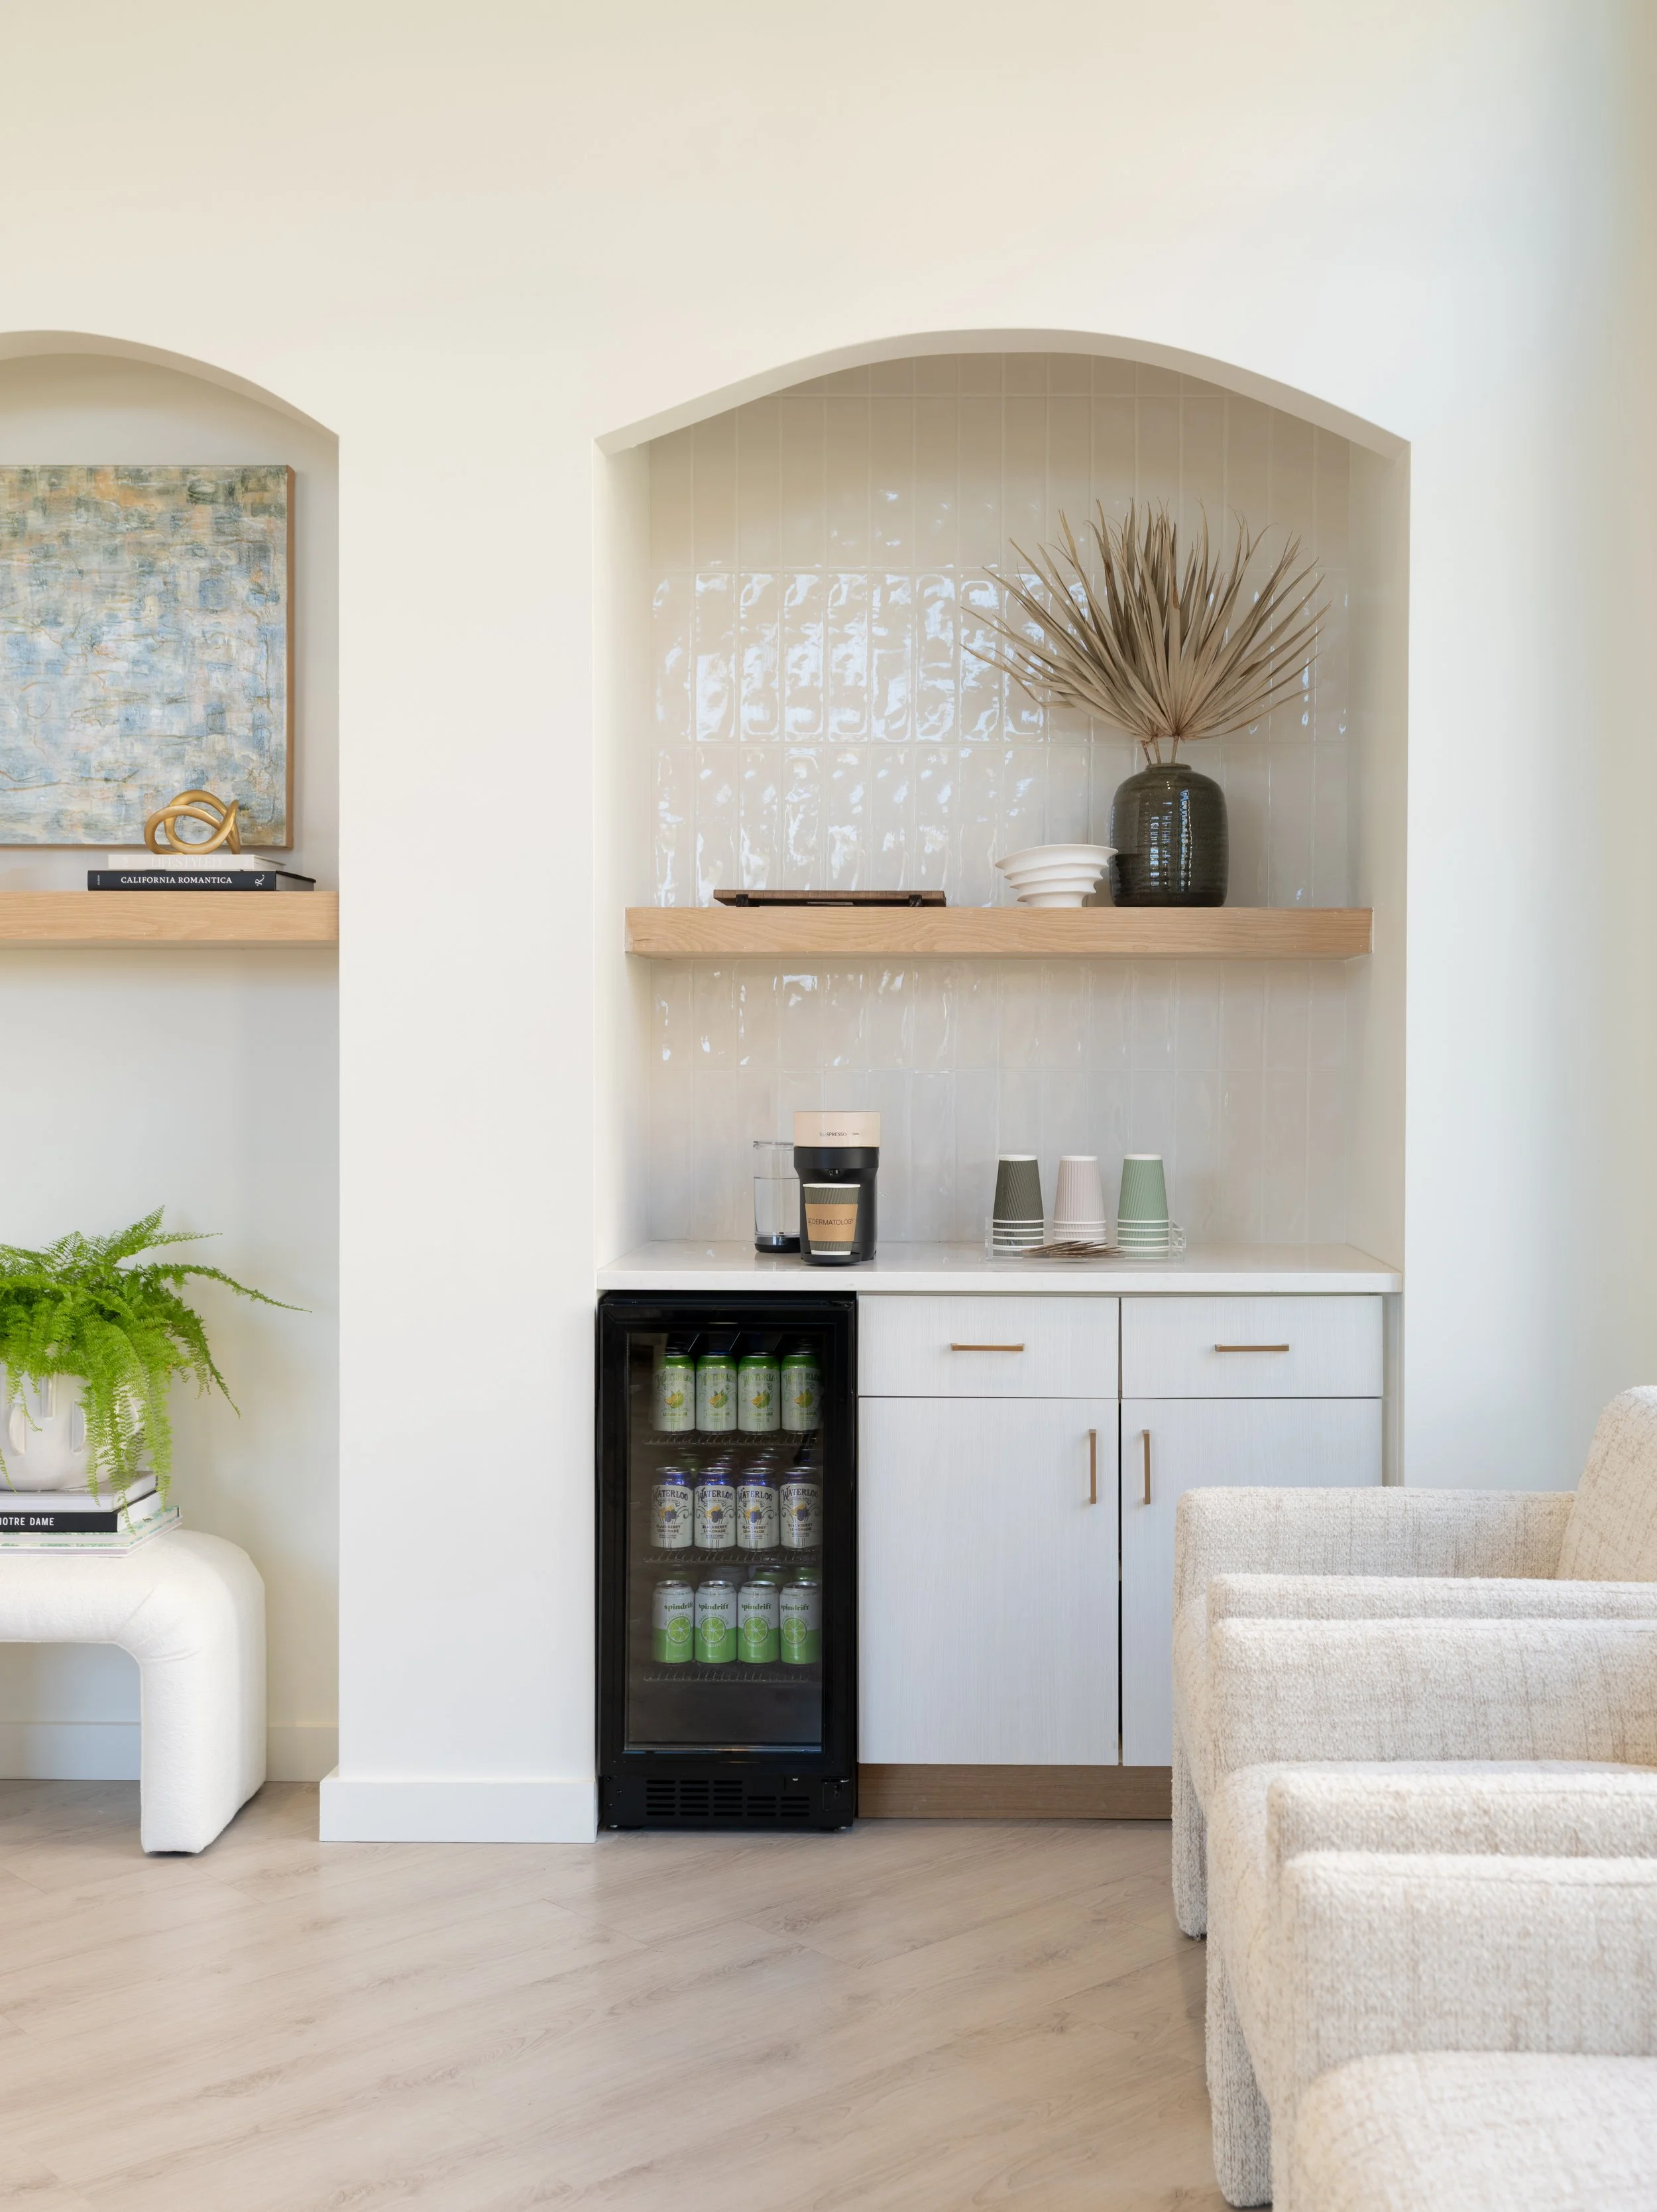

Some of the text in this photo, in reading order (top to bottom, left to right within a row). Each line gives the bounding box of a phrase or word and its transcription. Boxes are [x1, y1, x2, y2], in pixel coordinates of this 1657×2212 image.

[695, 1487, 733, 1504] WATERLOO
[737, 1487, 773, 1503] WATERLOO
[0, 1517, 54, 1526] OTRE DAME
